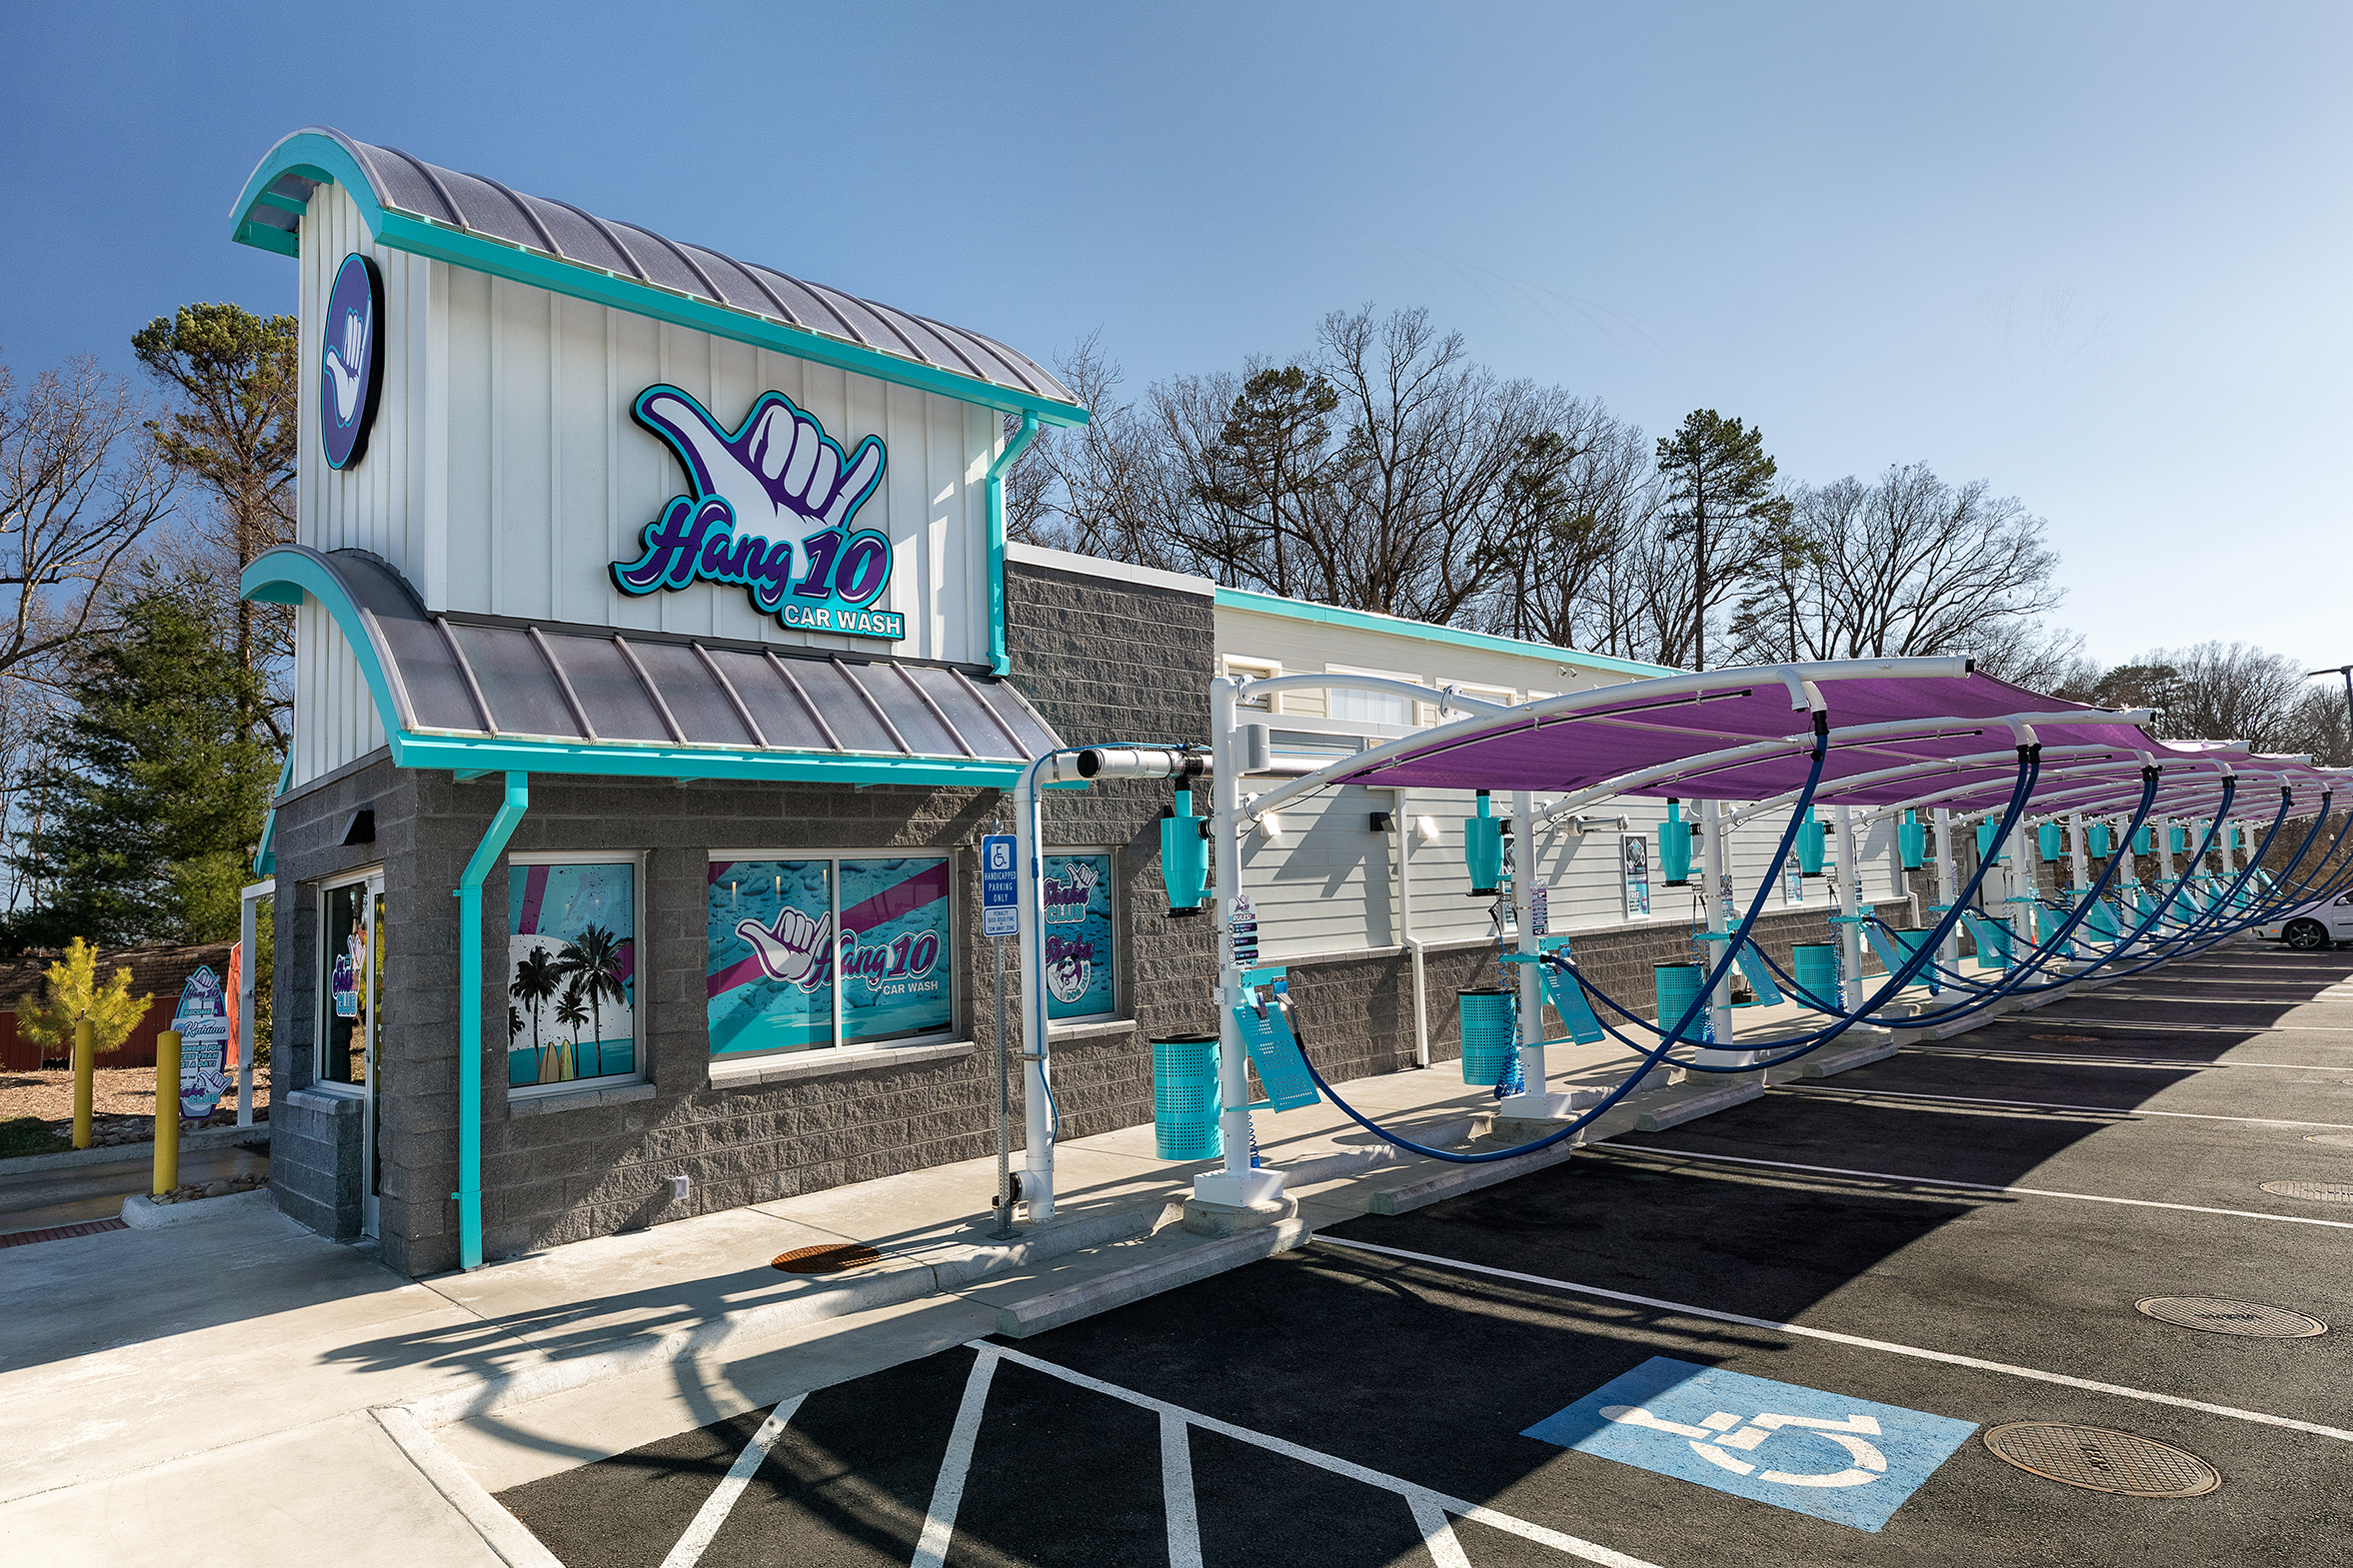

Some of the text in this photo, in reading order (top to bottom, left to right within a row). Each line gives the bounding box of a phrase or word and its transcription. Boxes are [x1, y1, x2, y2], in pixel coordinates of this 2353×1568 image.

[623, 500, 888, 605] Hang 10
[784, 604, 901, 636] CAR WASH
[985, 871, 1017, 880] HANDICAPPED
[988, 882, 1014, 891] PARKING
[1044, 879, 1090, 906] Shaka
[1047, 905, 1085, 921] CLUB
[803, 933, 938, 987] Hang 10
[205, 988, 220, 998] 10
[883, 980, 939, 995] CAR WASH
[1067, 987, 1082, 1000] DOG
[337, 993, 357, 1014] CLUB
[184, 1020, 226, 1037] Kahuna
[188, 1094, 219, 1103] CLUB
